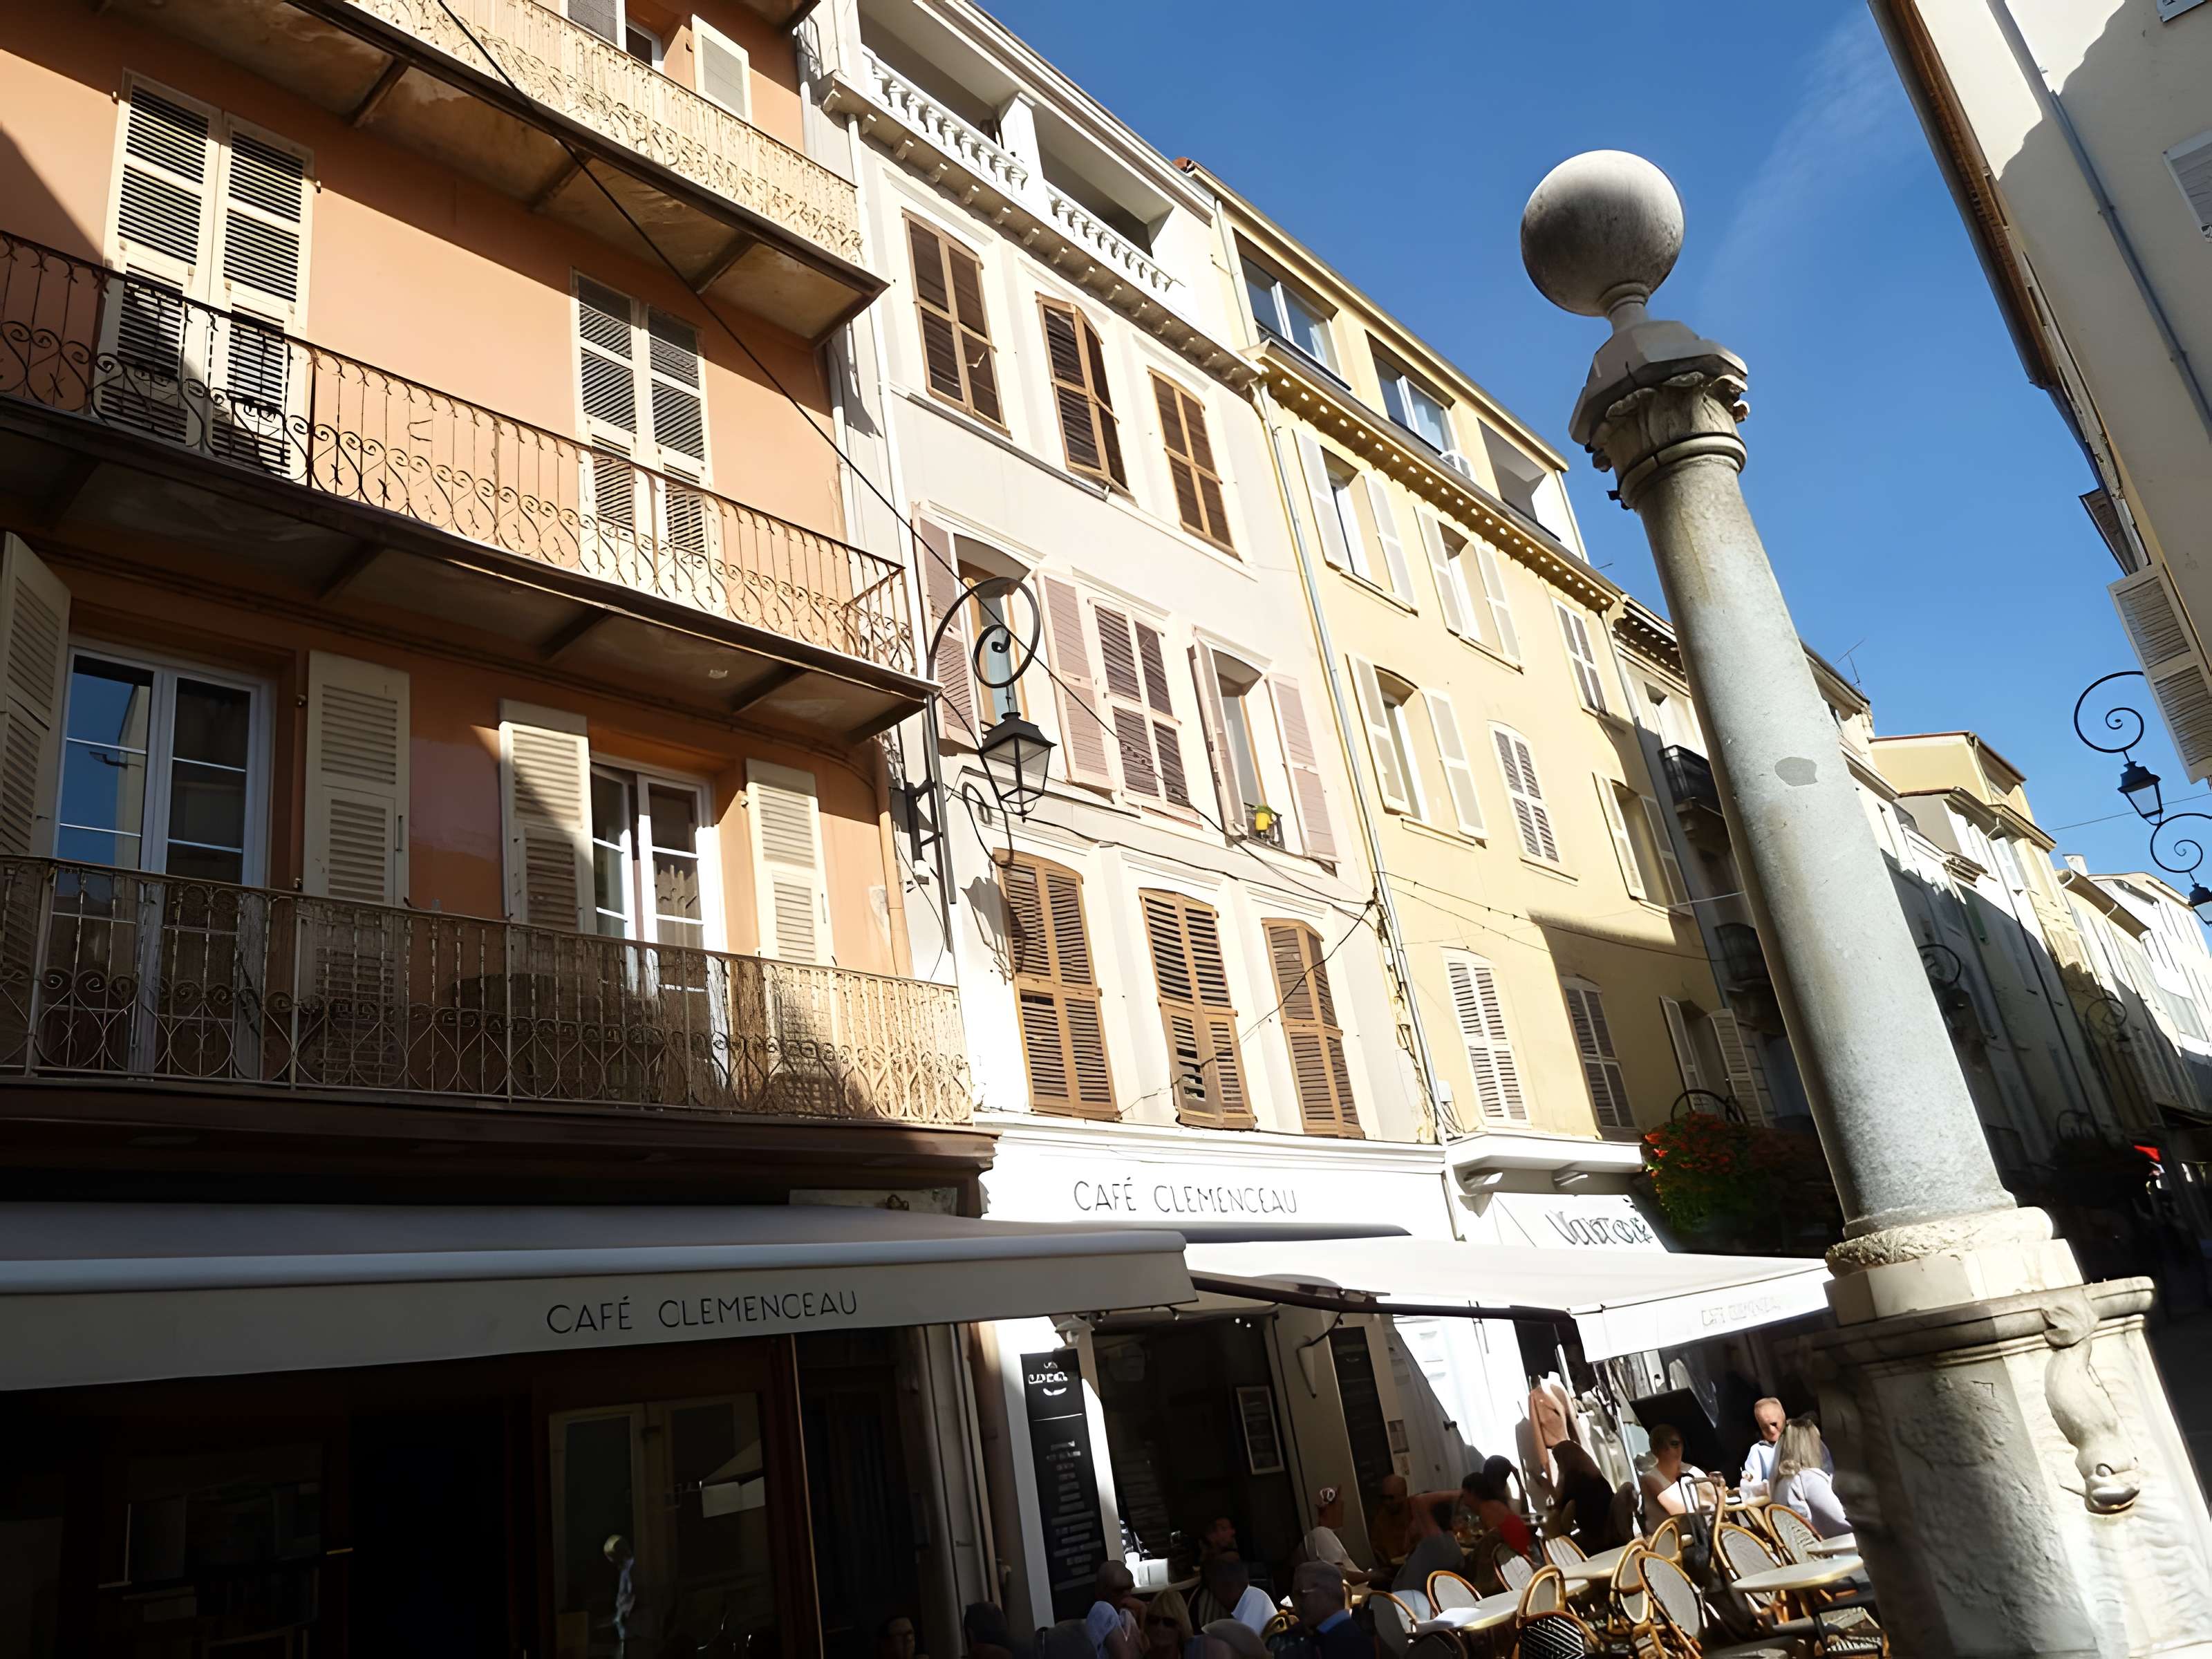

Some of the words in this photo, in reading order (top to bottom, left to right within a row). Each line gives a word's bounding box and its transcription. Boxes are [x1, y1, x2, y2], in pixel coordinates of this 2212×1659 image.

[1074, 1177, 1136, 1211] CAFÉ
[1154, 1185, 1297, 1214] CLEMENCEAU
[546, 1295, 632, 1334] CAFÉ
[658, 1290, 858, 1328] CLEMENCEAU
